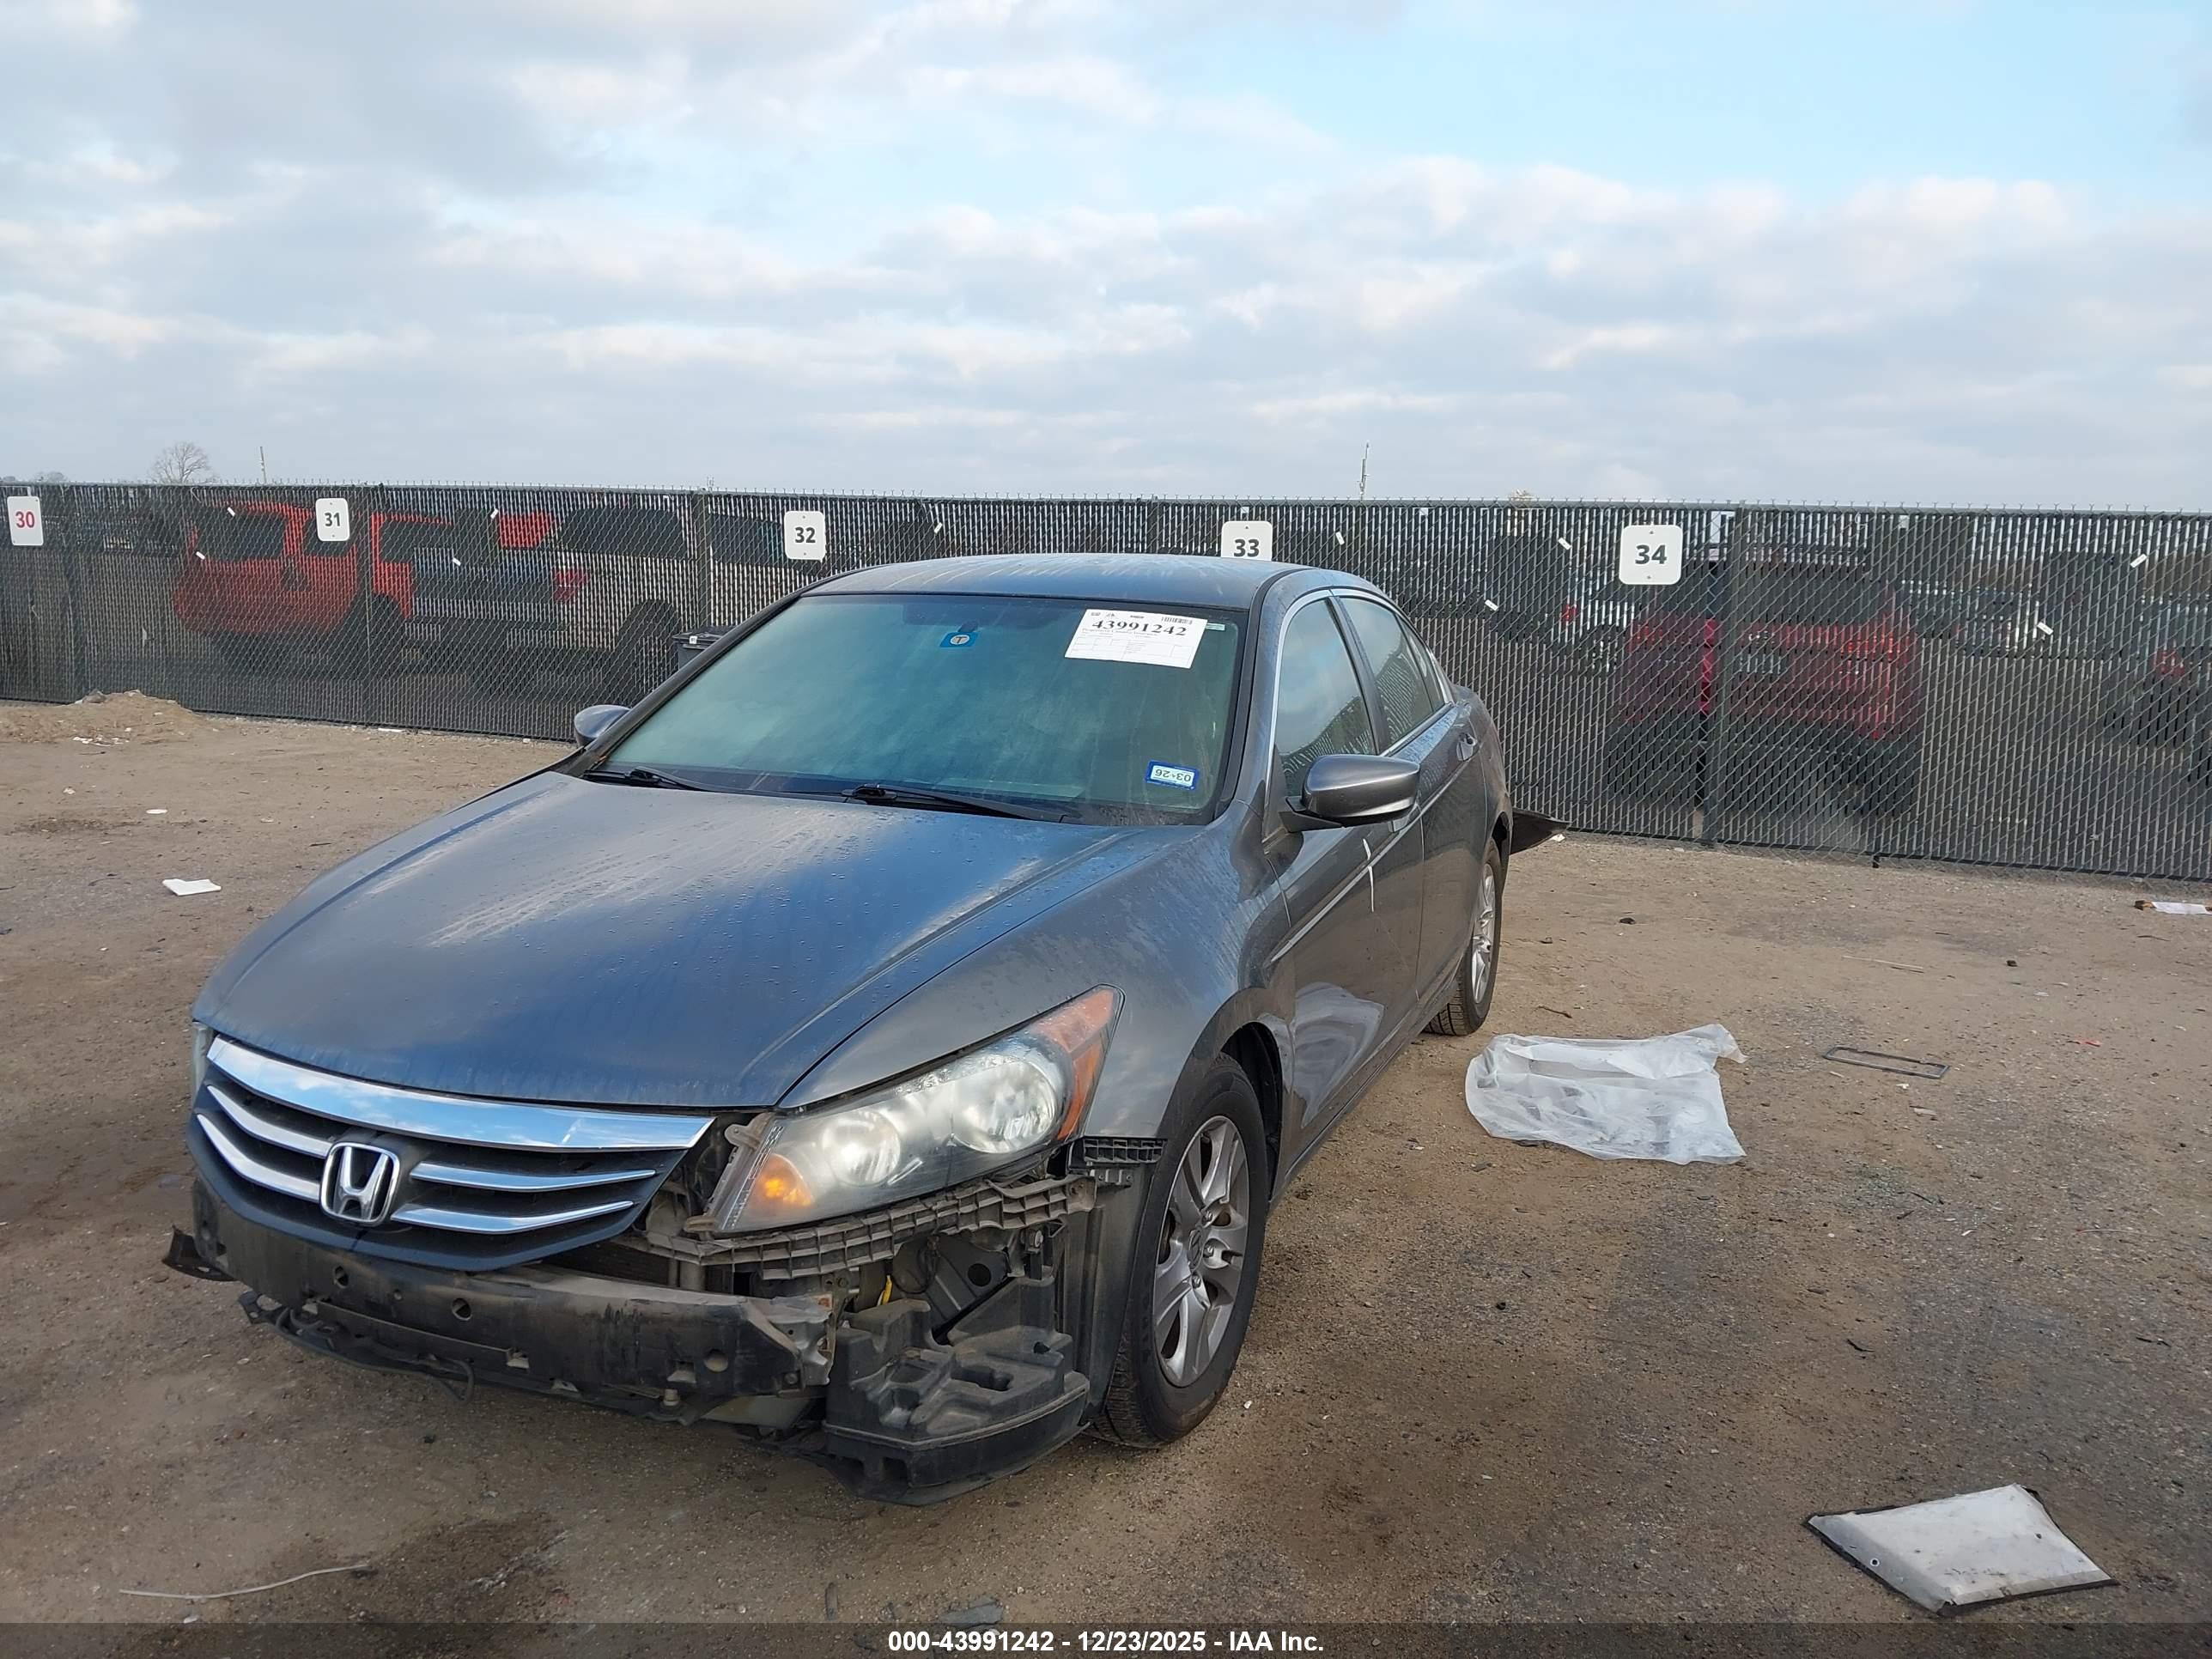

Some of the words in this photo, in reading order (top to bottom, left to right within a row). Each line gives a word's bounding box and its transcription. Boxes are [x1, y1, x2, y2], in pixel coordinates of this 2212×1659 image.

[15, 511, 35, 528] 30
[324, 512, 341, 527] 31
[794, 526, 816, 544] 32
[1233, 538, 1260, 557] 33
[1634, 544, 1668, 564] 34
[1091, 620, 1187, 636] 43991242
